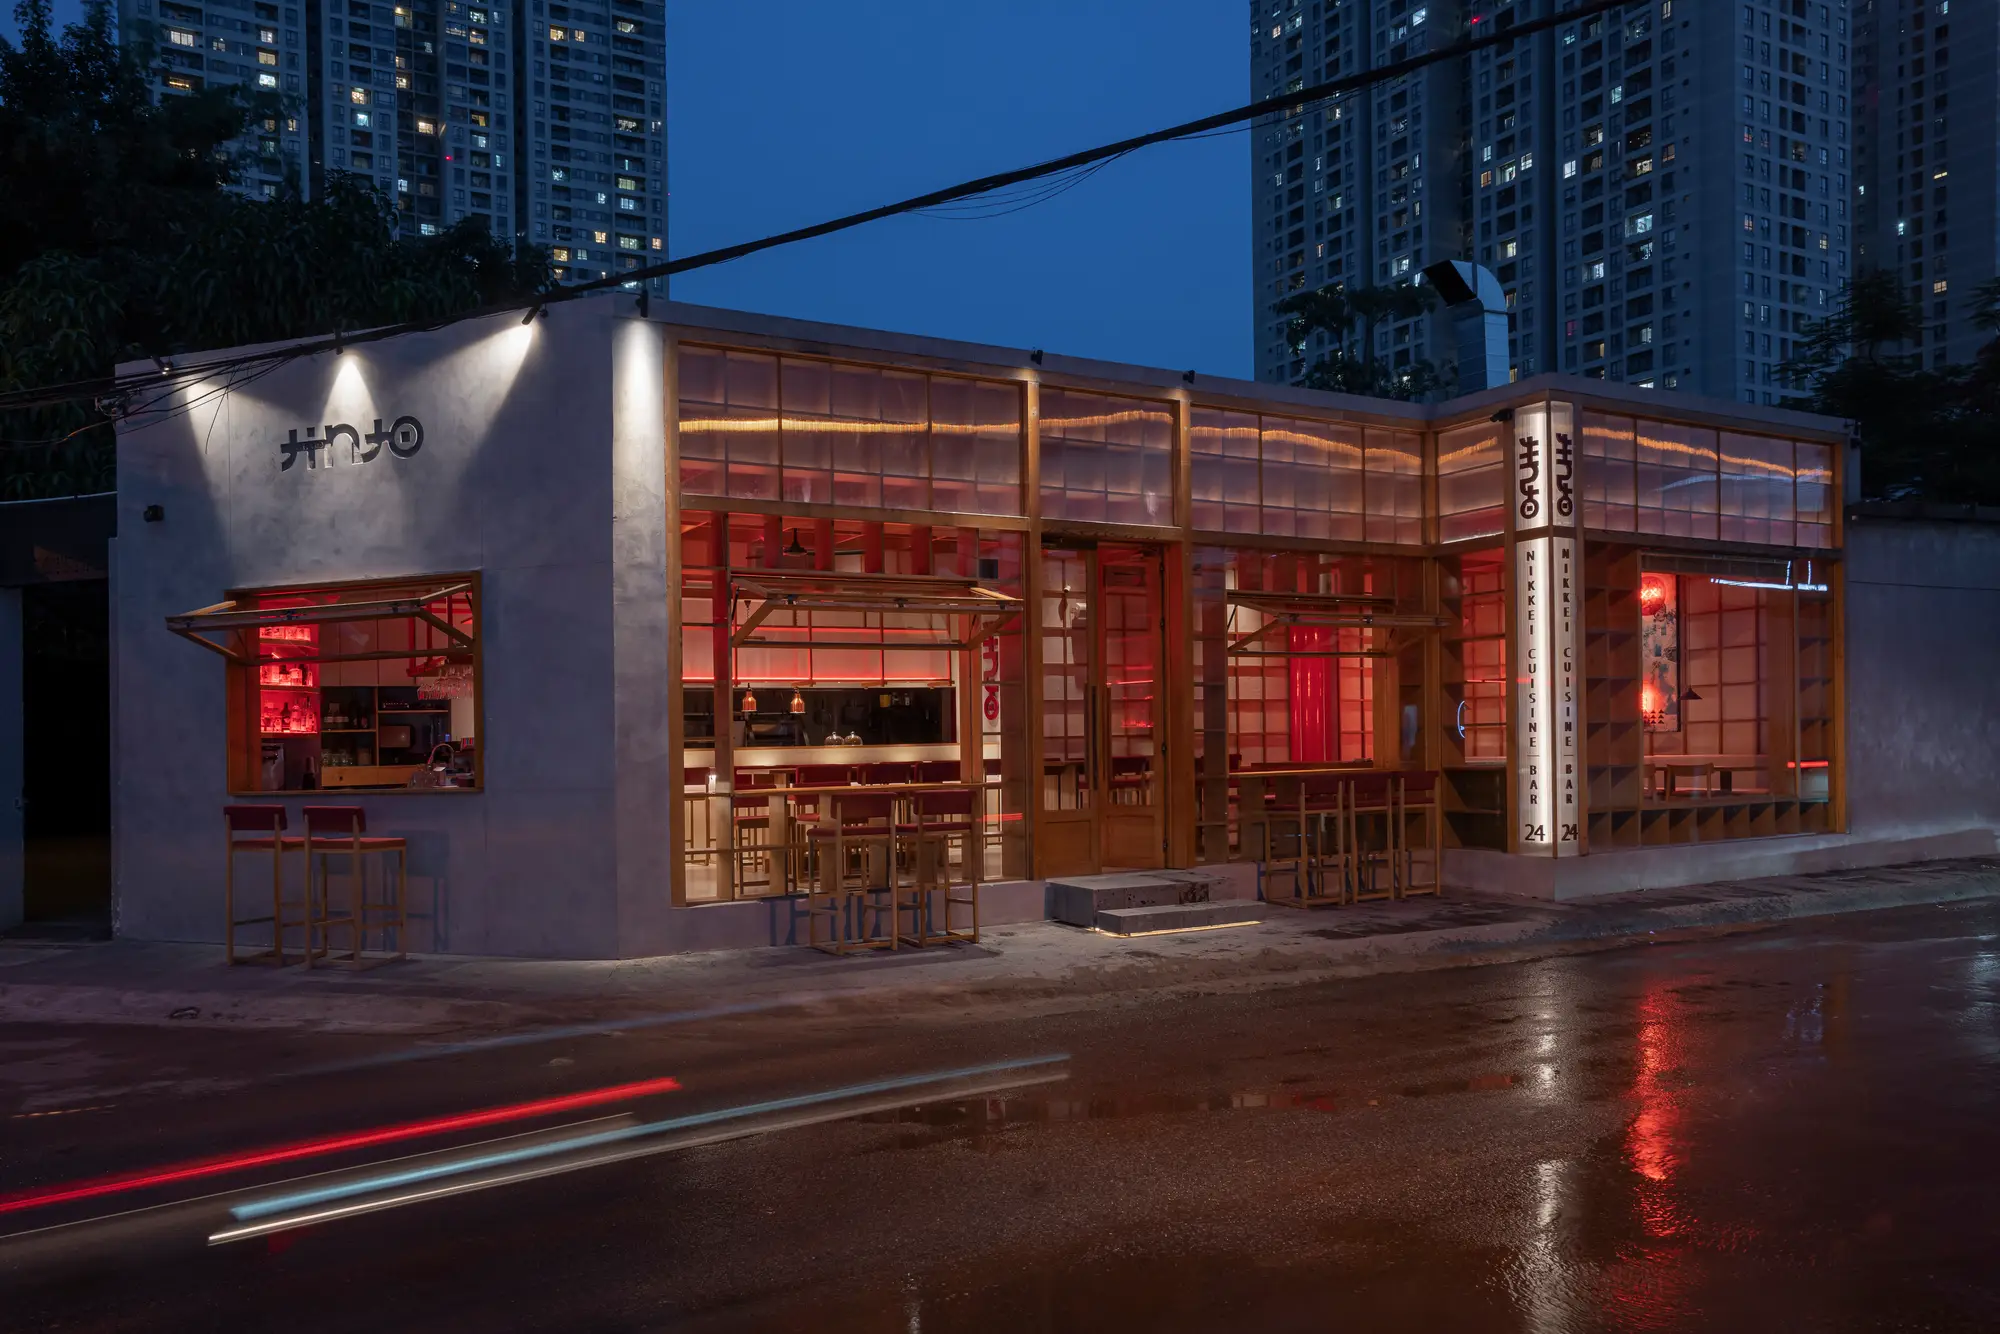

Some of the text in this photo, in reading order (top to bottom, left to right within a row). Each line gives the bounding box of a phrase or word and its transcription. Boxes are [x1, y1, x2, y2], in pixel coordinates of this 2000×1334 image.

[1526, 550, 1538, 805] NIKKEI CUISINE BAR
[1561, 548, 1573, 804] NIKKEI CUISINE BAR
[1524, 824, 1546, 842] 24
[1561, 823, 1579, 842] 24
